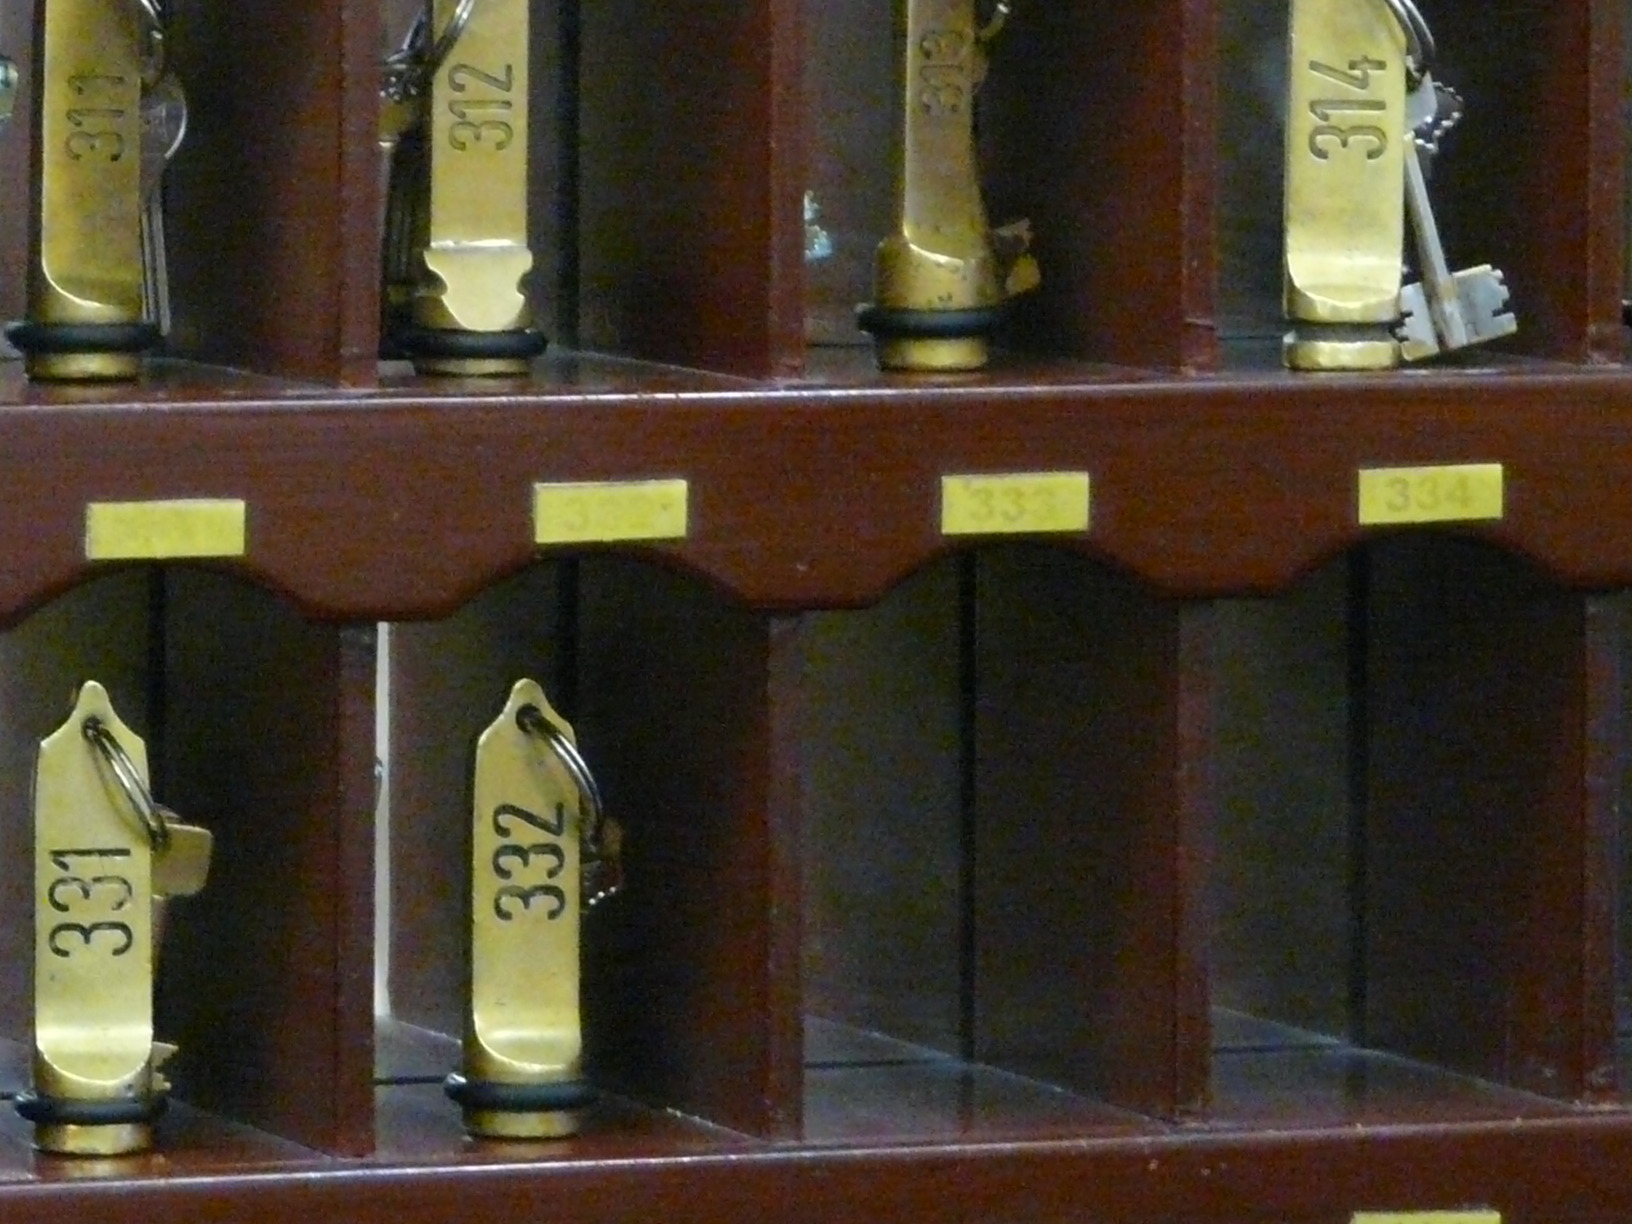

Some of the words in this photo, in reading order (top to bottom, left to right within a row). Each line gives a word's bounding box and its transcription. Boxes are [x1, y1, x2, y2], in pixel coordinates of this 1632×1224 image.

[447, 62, 514, 154] 312
[919, 29, 968, 115] 313
[1307, 53, 1389, 162] 314
[65, 74, 126, 163] 311
[968, 485, 1055, 524] 333
[1385, 475, 1470, 512] 334
[48, 844, 135, 959] 331
[491, 800, 566, 924] 332
